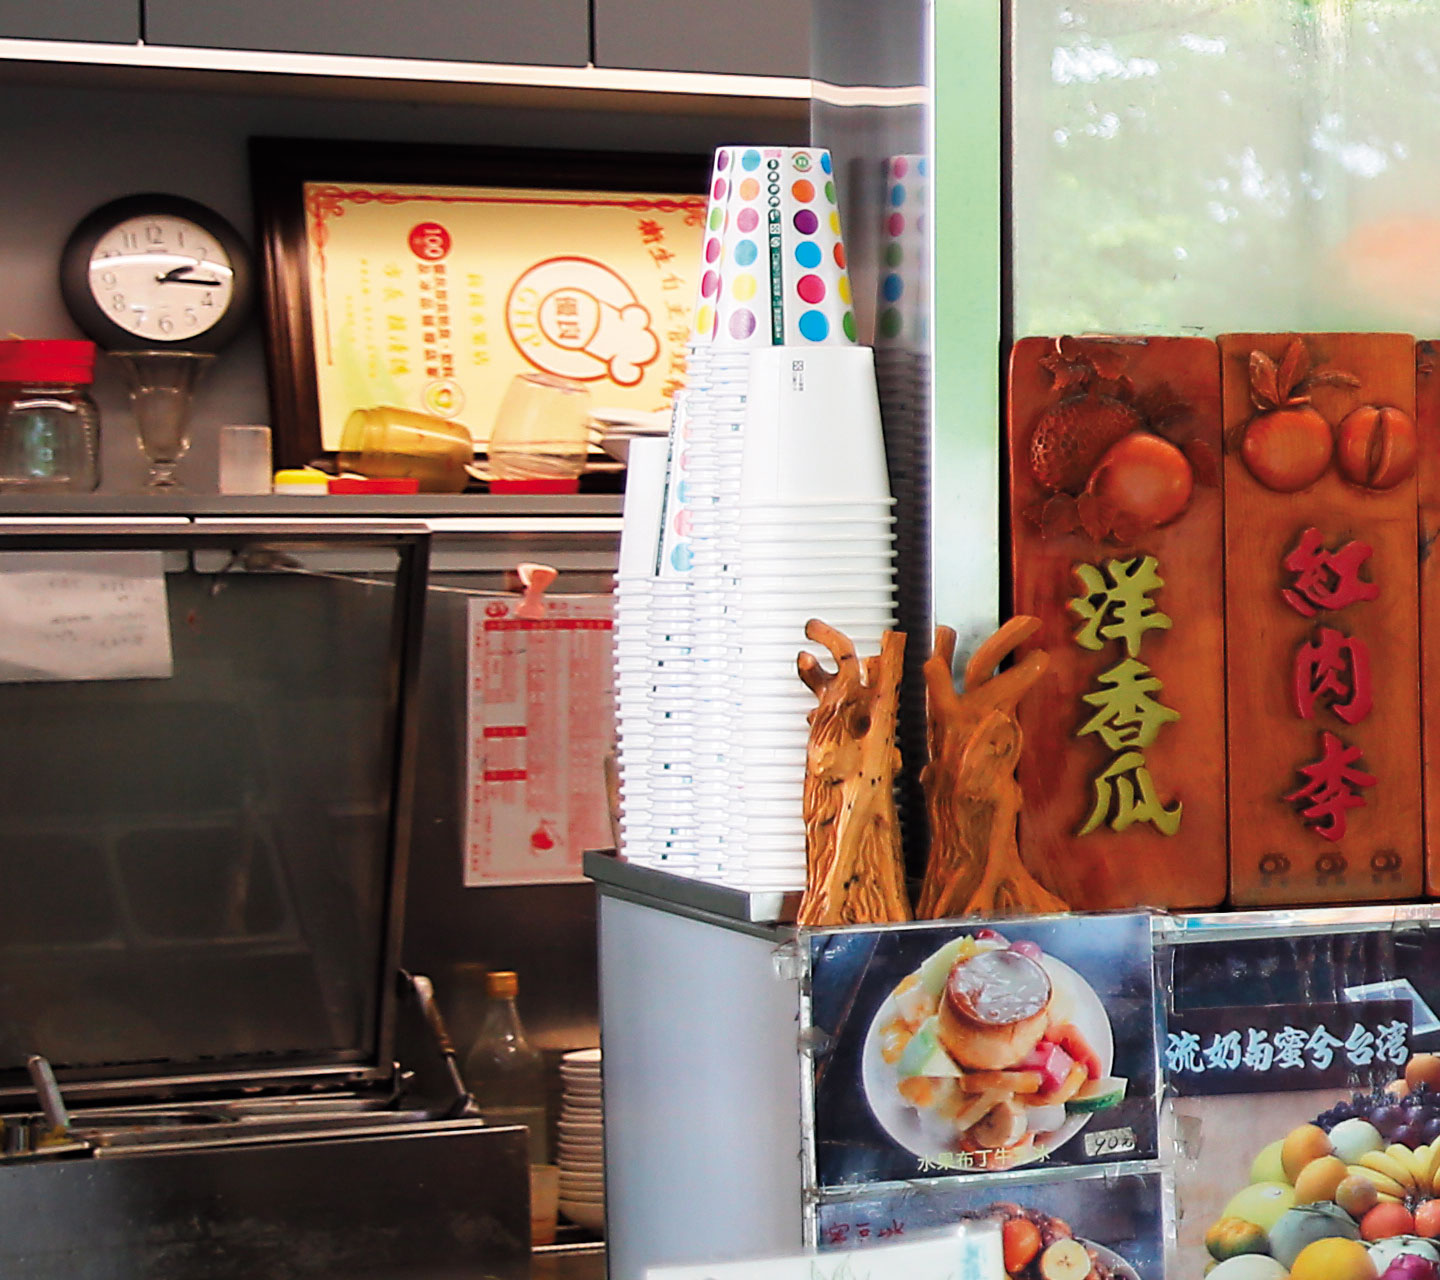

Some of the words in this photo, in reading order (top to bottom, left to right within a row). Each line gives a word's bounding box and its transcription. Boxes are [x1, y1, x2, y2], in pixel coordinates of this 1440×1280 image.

[1066, 555, 1185, 838] 洋香瓜
[1283, 527, 1380, 842] 紅肉李
[917, 1144, 1051, 1172] 水果布丁牛冰
